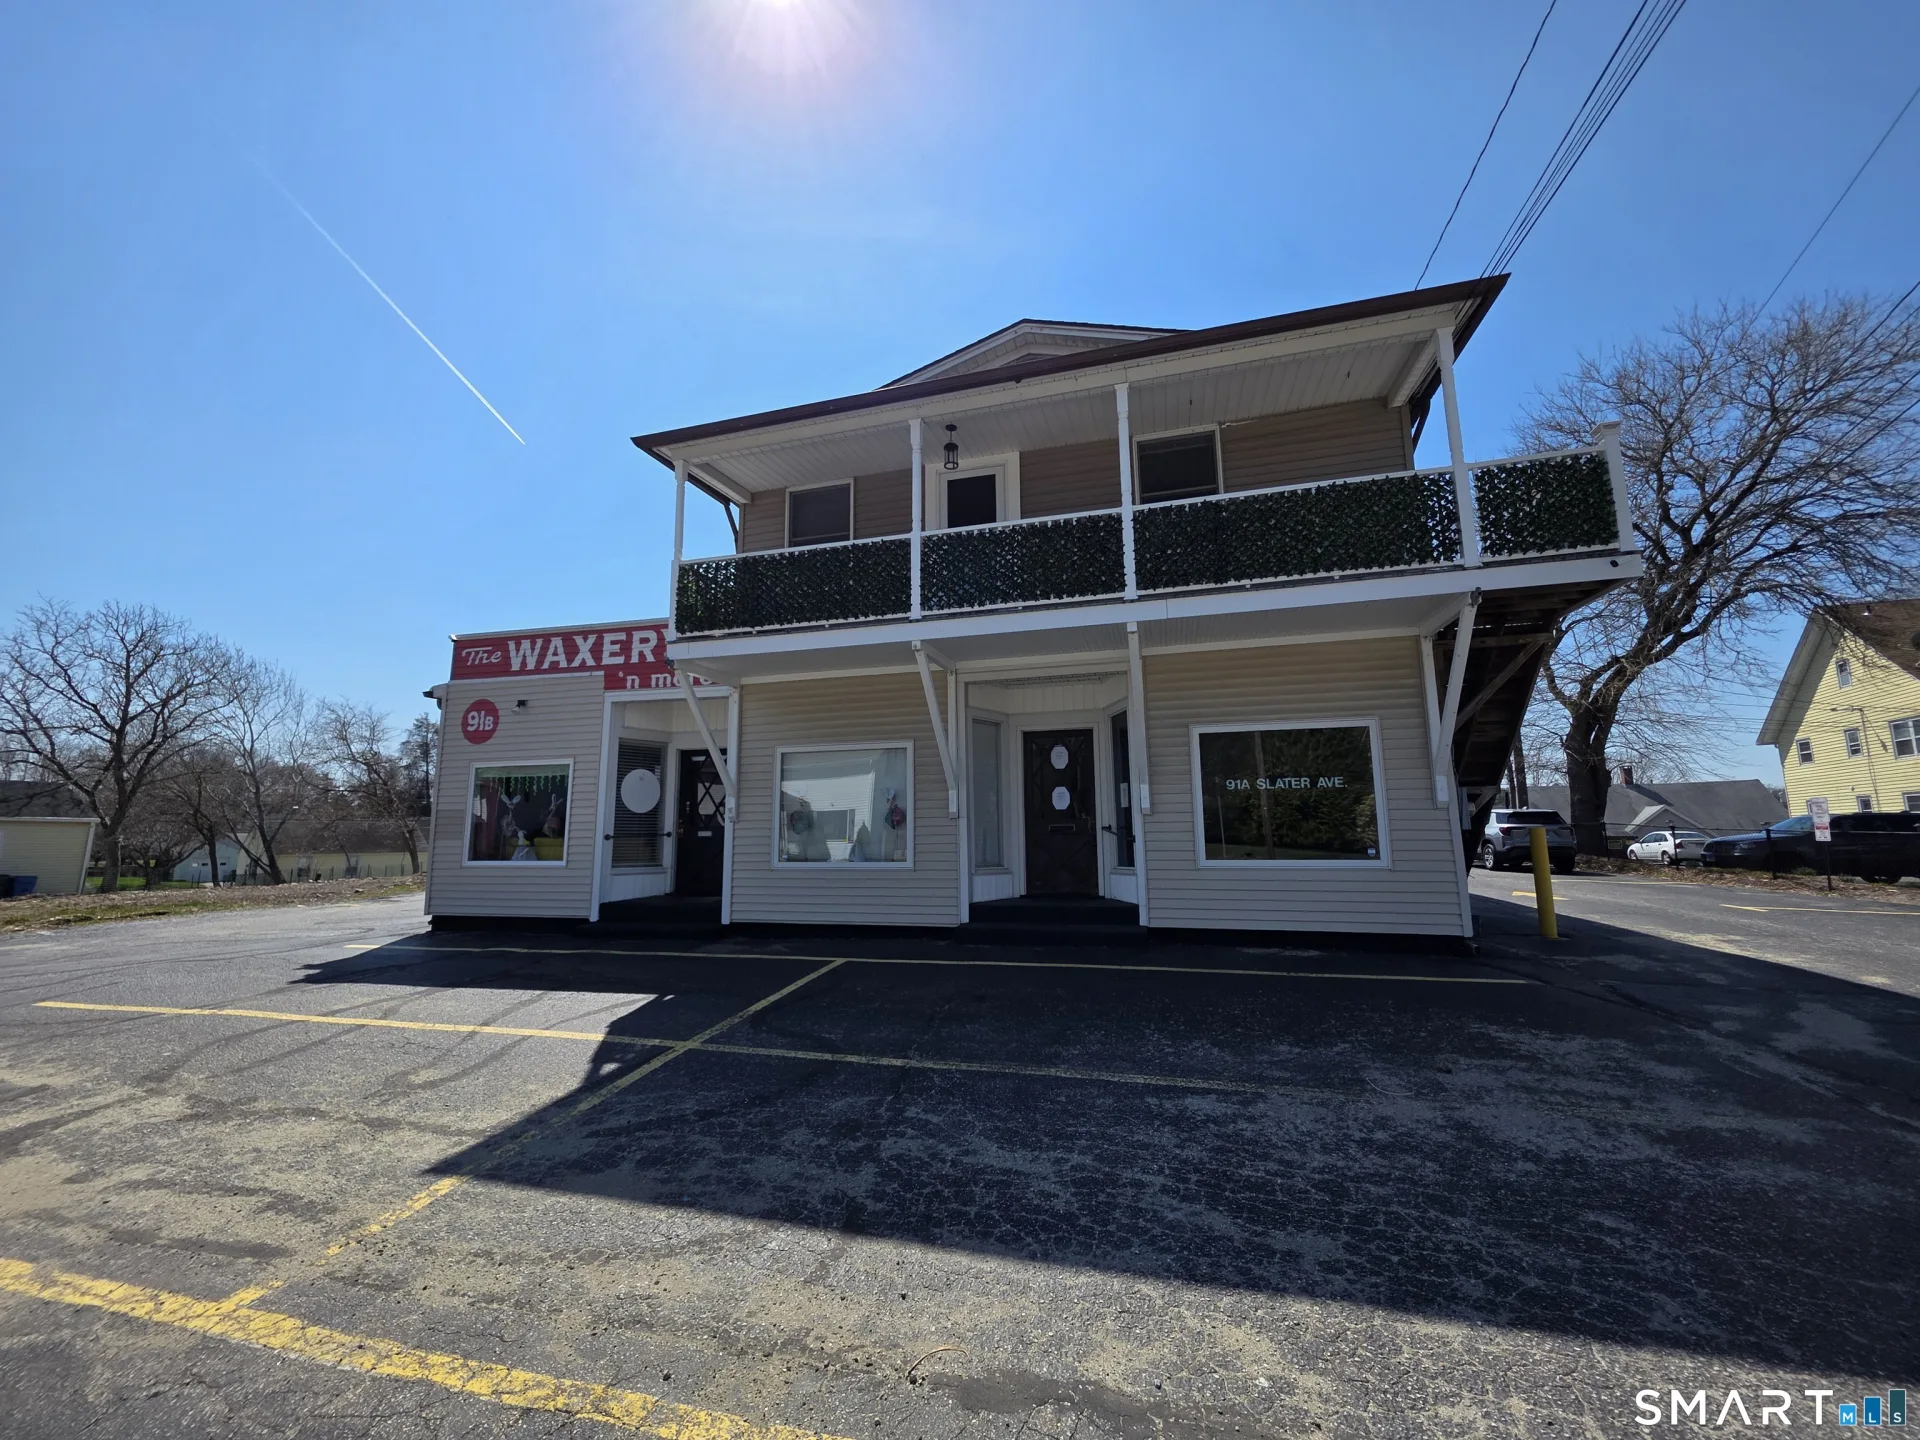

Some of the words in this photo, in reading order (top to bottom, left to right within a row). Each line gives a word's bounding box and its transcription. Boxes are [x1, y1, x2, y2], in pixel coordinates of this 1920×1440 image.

[462, 646, 502, 666] The
[466, 710, 494, 732] 91B
[1226, 779, 1250, 791] 91A
[1256, 777, 1311, 790] SLATER
[1317, 776, 1348, 789] AVE.
